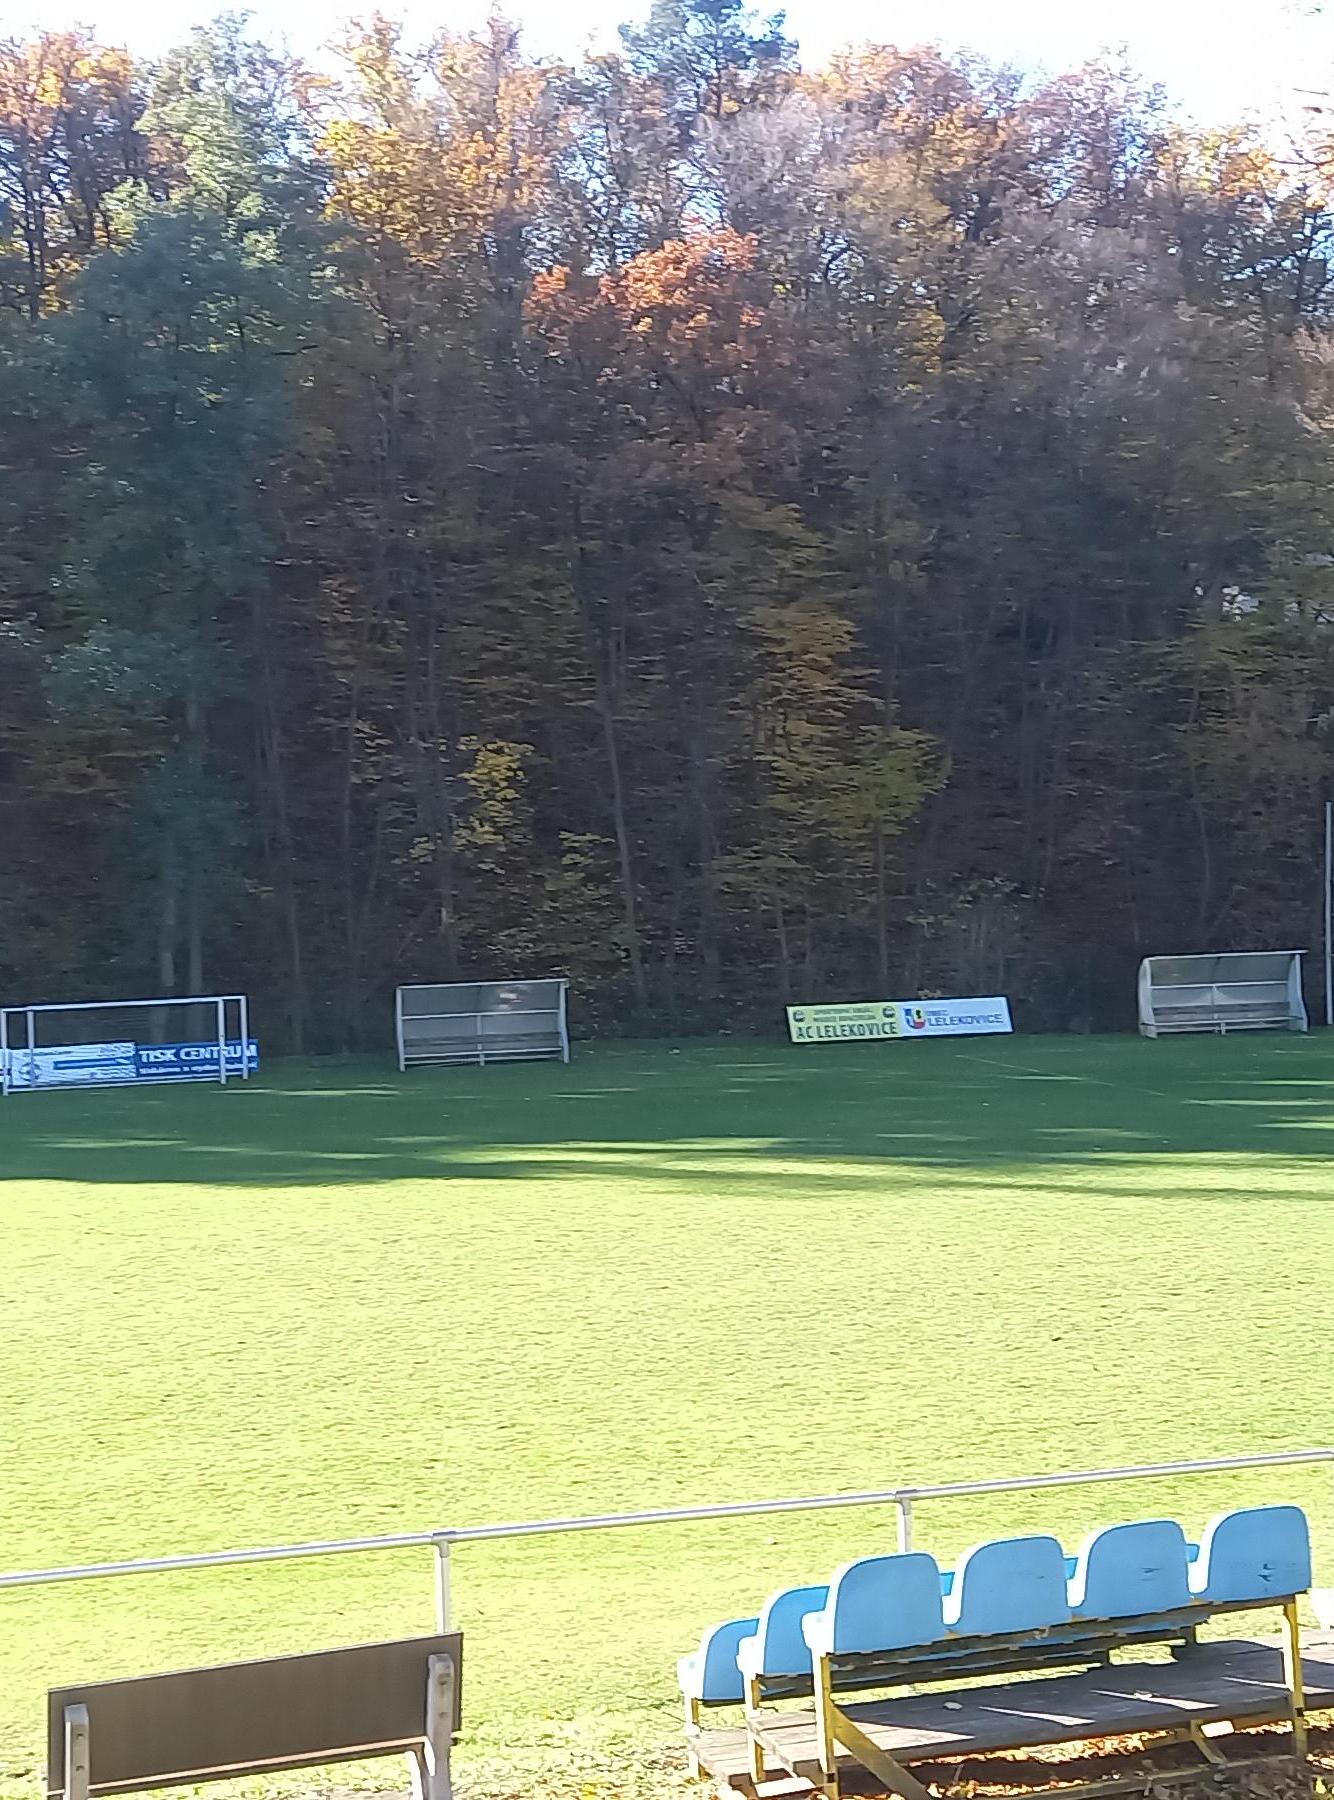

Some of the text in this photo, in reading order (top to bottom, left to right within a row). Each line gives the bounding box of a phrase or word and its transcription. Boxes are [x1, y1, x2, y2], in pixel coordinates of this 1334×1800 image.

[928, 1013, 1004, 1027] LELEKOVICE
[796, 1022, 898, 1039] AC LELEKOVICE
[138, 1049, 177, 1063] TISK
